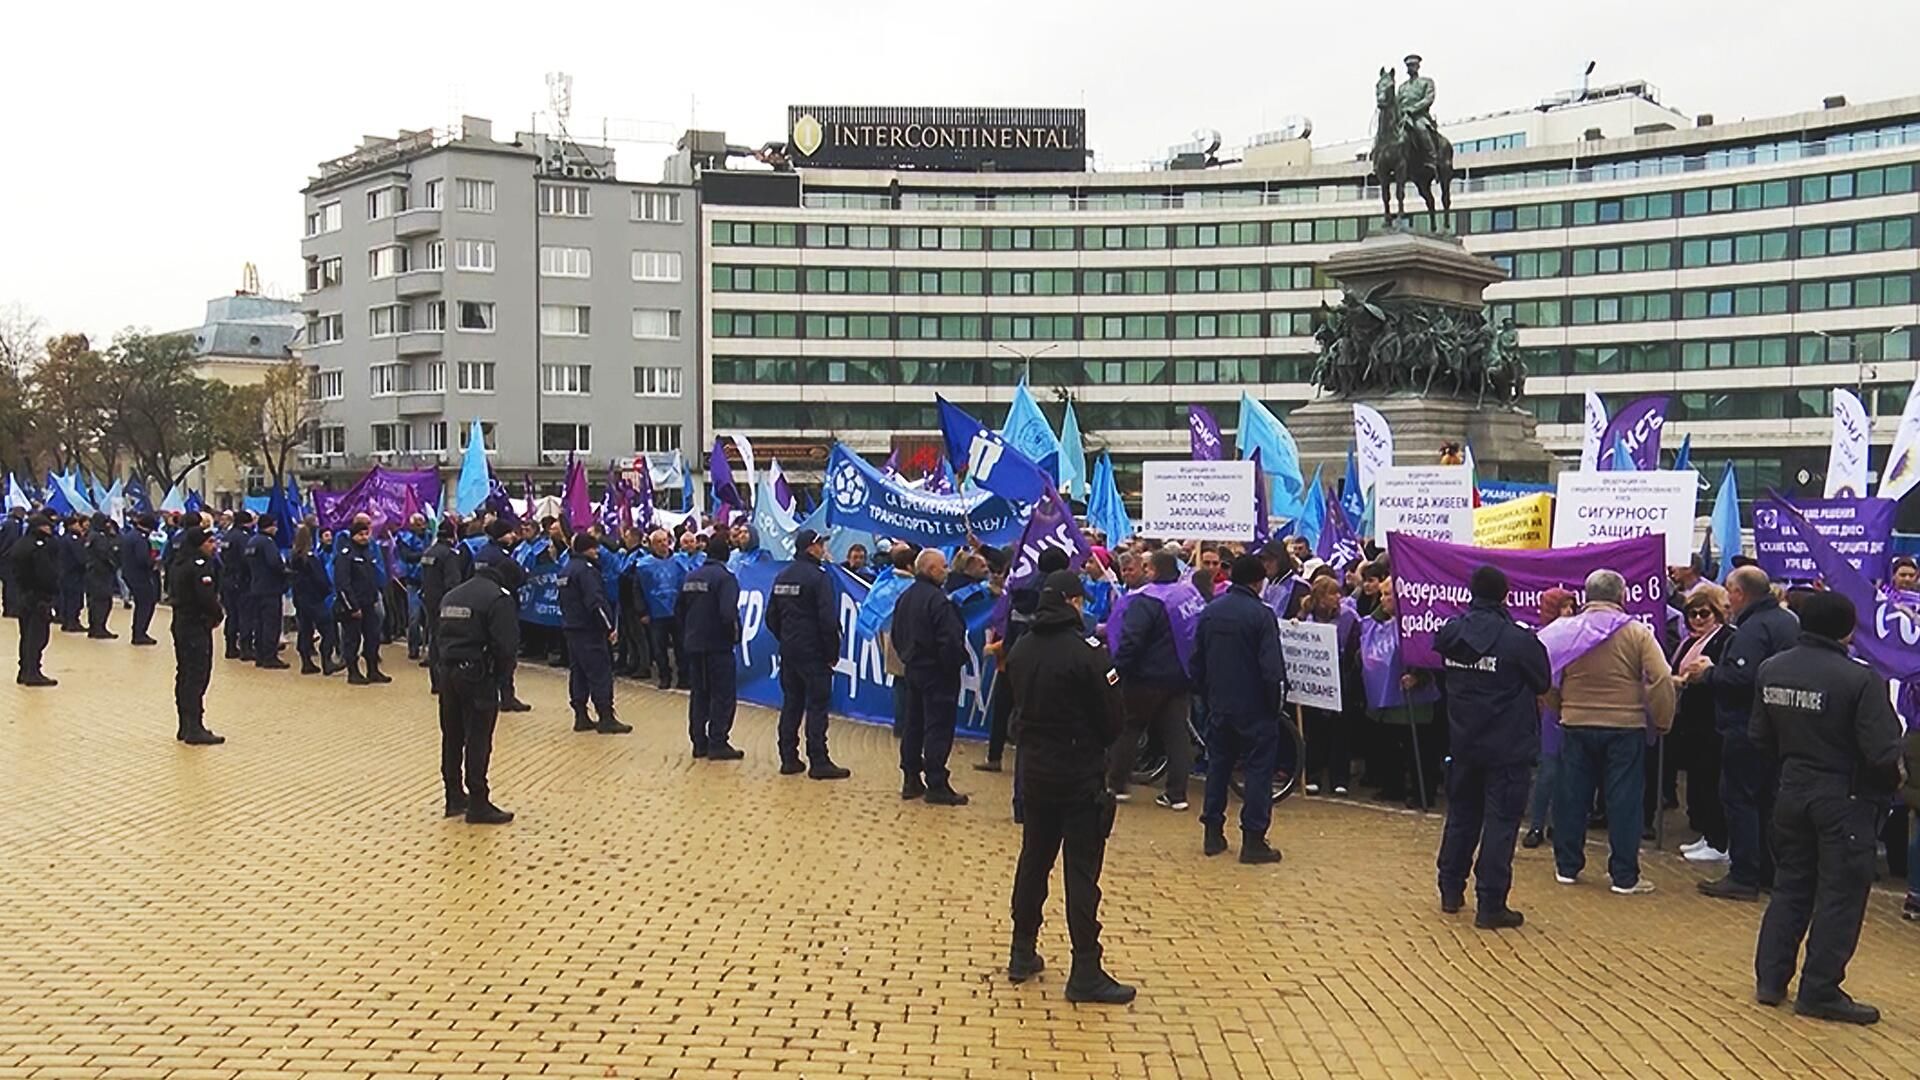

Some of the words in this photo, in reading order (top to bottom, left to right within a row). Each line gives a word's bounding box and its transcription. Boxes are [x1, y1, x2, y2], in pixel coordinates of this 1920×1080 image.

[833, 123, 1074, 150] INTERCONTINENTAL
[1578, 505, 1669, 520] СИГУРНОСТ
[1588, 523, 1652, 539] ЗАЩИТА
